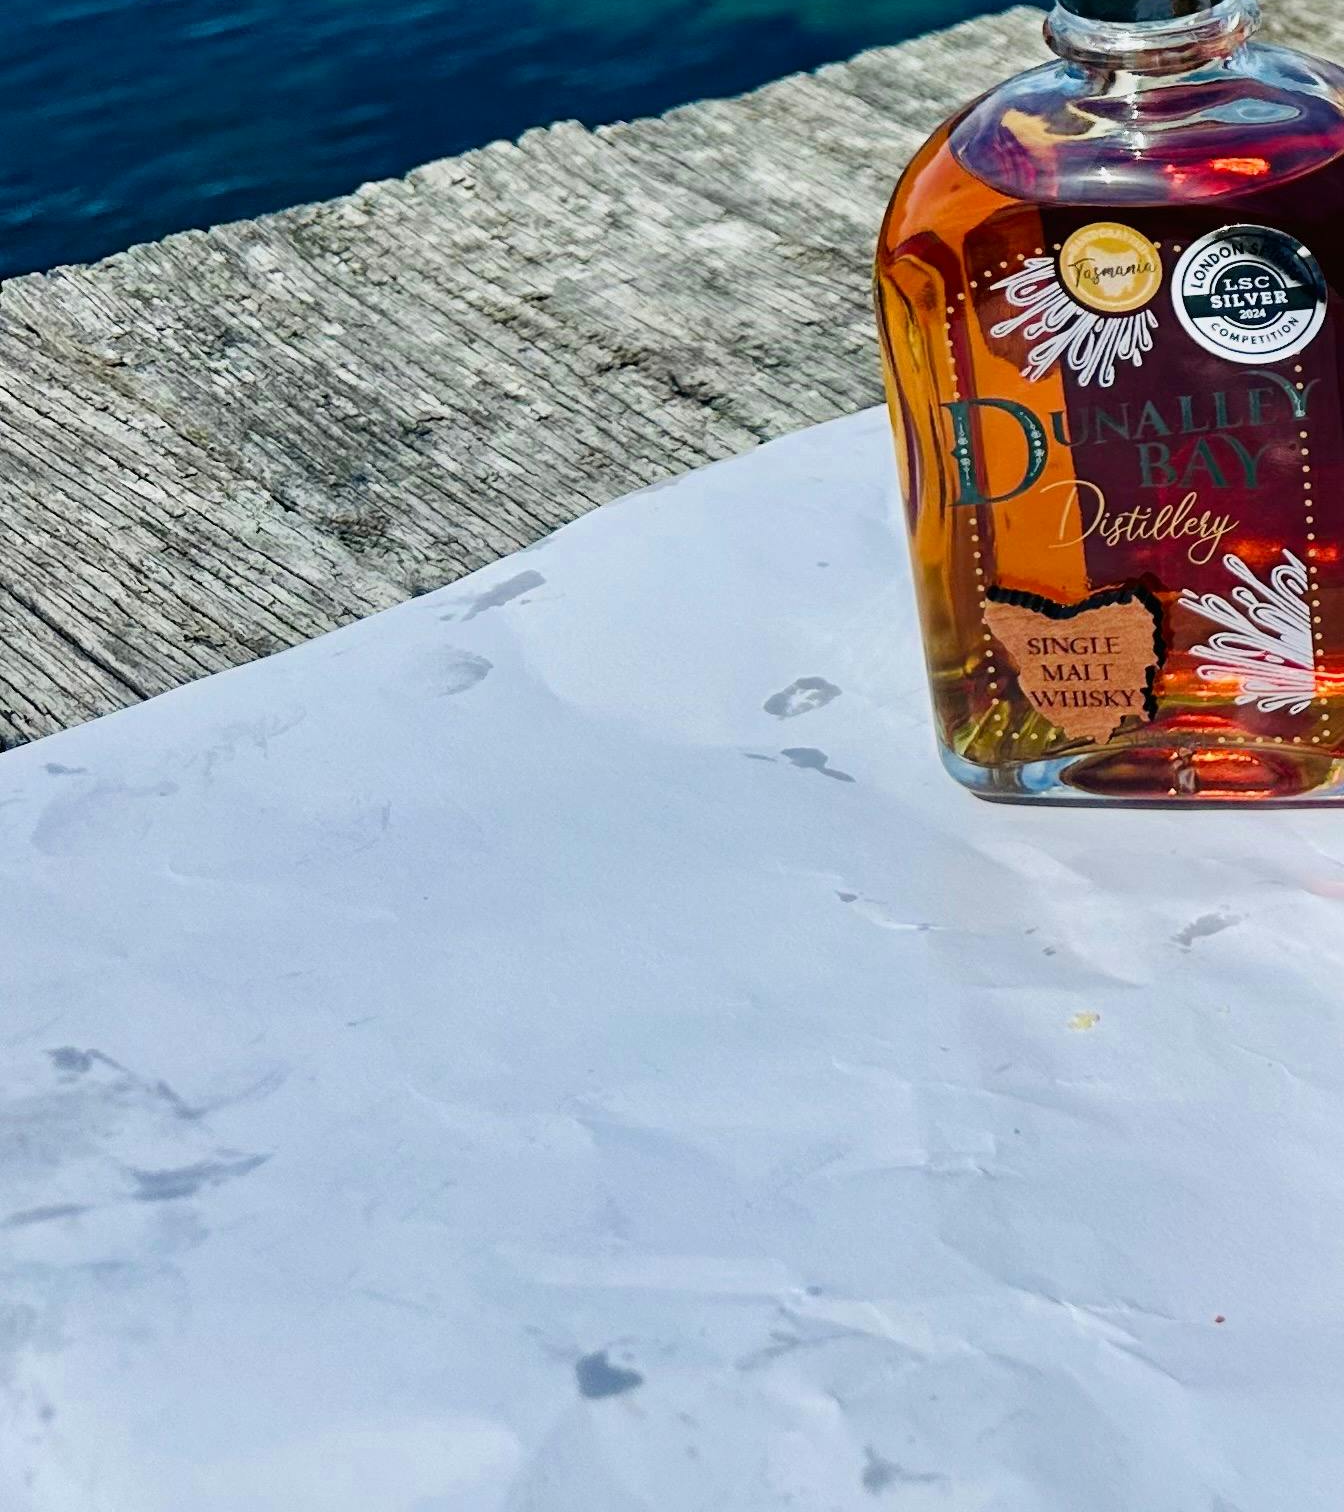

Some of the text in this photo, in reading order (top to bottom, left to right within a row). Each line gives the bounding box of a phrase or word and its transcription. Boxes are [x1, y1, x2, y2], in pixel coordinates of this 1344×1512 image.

[1067, 257, 1157, 288] Tasmania
[1191, 242, 1245, 289] LONDON
[1223, 275, 1270, 292] LSC
[1209, 290, 1289, 309] SILVER
[1239, 308, 1267, 320] 2024
[1211, 316, 1300, 345] COMPETITION
[1136, 433, 1277, 489] BAY
[1040, 479, 1240, 565] Distillery
[1027, 636, 1122, 655] SINGLE
[1041, 662, 1115, 682] MALT
[1030, 688, 1136, 707] WHISKY
